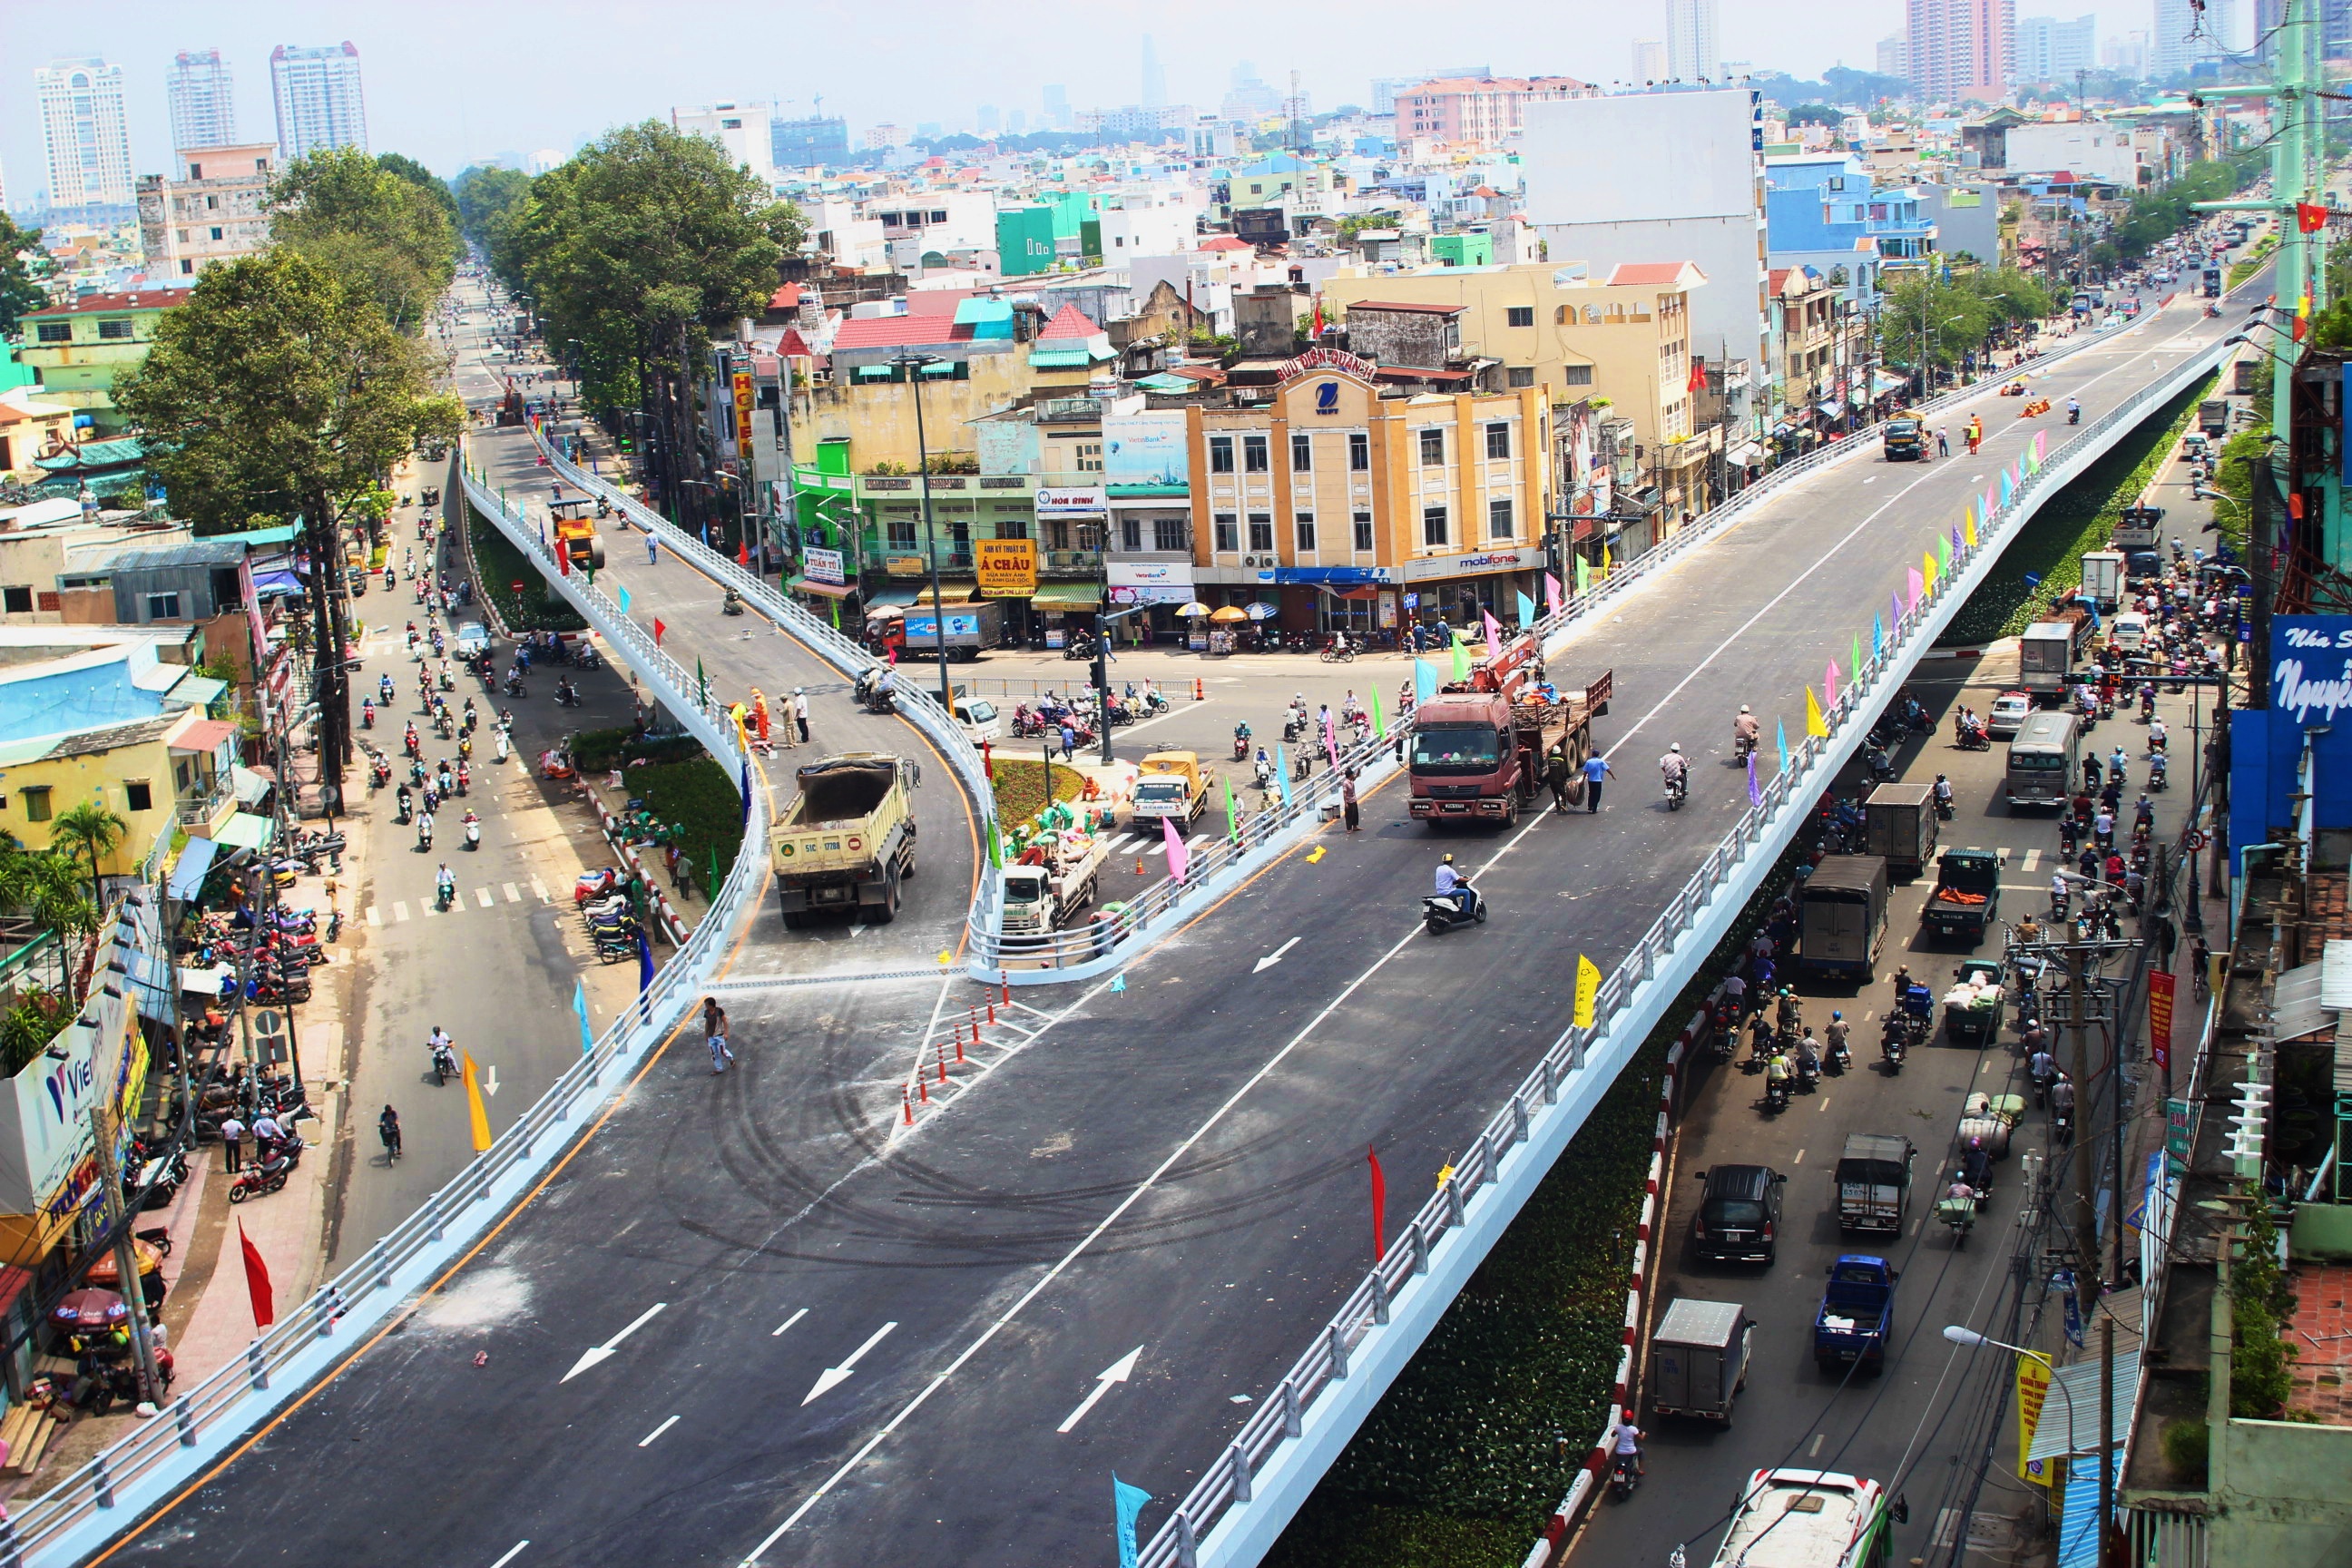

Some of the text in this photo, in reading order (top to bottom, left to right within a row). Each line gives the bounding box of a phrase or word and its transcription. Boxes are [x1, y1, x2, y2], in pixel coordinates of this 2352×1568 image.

[1128, 436, 1161, 444] VietinBank
[993, 556, 1031, 571] CHÂU
[1460, 554, 1517, 568] mobifone
[2109, 674, 2121, 686] 14
[805, 843, 817, 853] 51C
